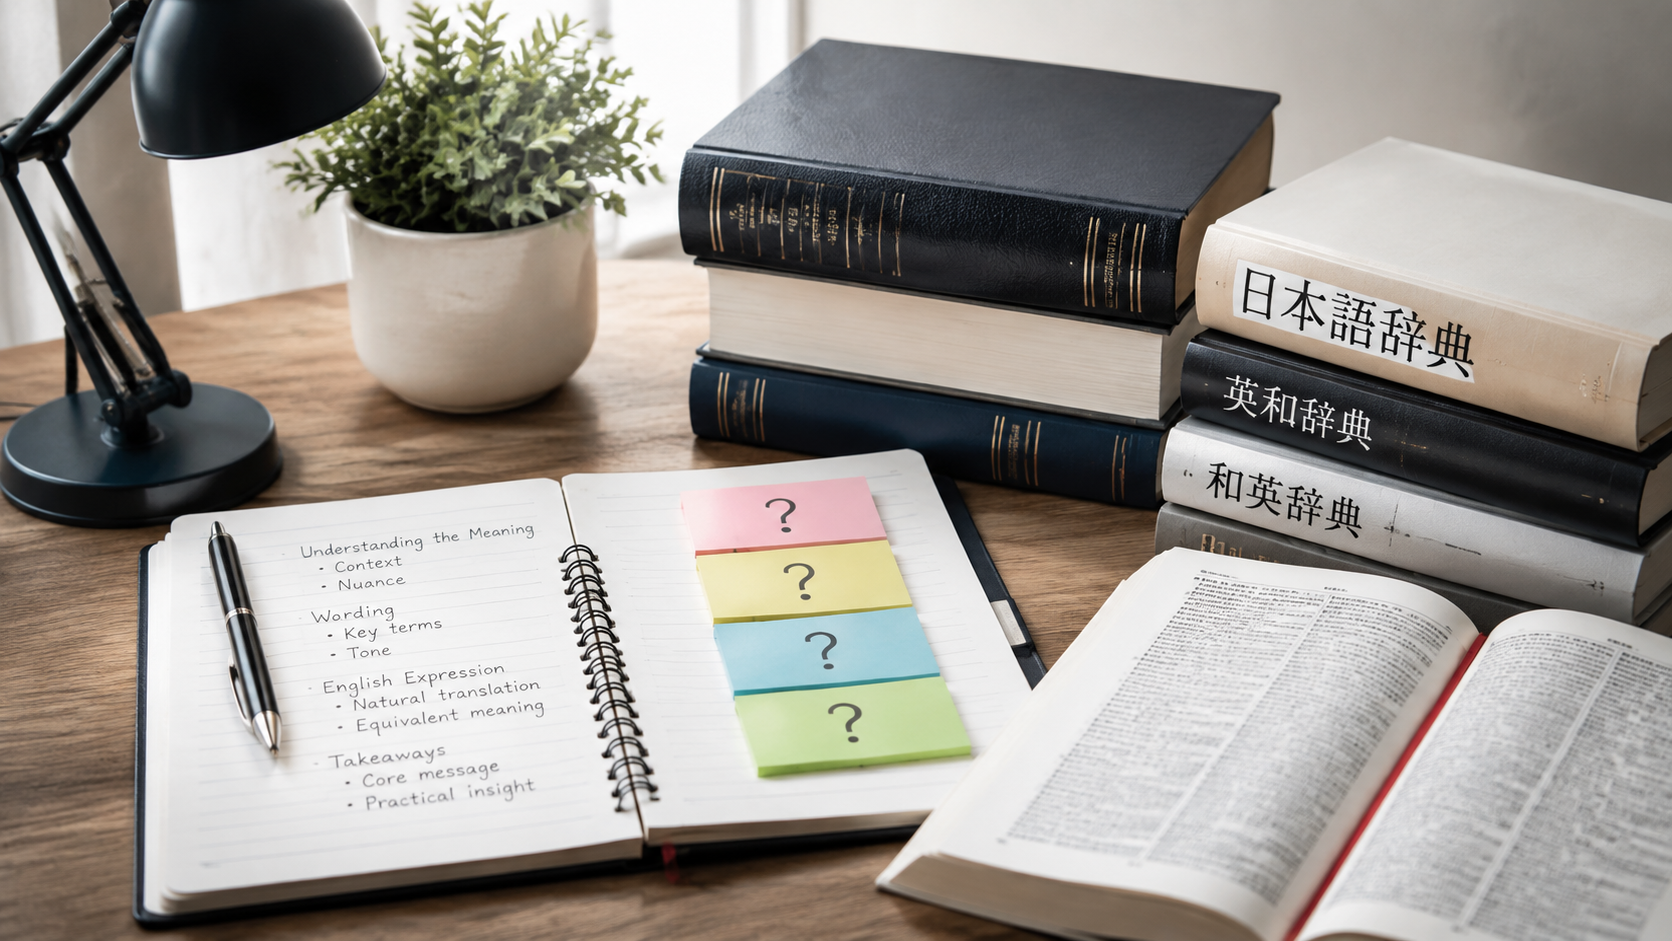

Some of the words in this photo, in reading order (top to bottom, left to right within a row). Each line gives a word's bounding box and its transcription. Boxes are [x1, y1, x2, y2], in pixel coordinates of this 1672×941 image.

[1242, 267, 1474, 378] 日本語辞典
[1223, 375, 1372, 451] 英和辞典
[765, 498, 797, 533] ?
[1206, 462, 1362, 539] 和英辞典
[300, 535, 424, 559] Understanding
[432, 531, 460, 544] the
[469, 524, 535, 540] Meaning
[334, 556, 403, 573] Context
[783, 563, 815, 600] ?
[337, 574, 406, 591] Nuance
[311, 604, 395, 624] Wording
[344, 626, 378, 643] Key
[389, 618, 443, 635] terms
[346, 645, 392, 660] Tone
[804, 631, 838, 670] ?
[323, 674, 393, 698] English
[404, 663, 506, 688] Expression
[353, 690, 426, 711] Natural
[438, 680, 541, 701] translation
[357, 708, 459, 736] Equivalent
[470, 700, 545, 718] meaning
[827, 702, 862, 743] ?
[328, 745, 446, 769] Takeaways
[362, 772, 408, 788] Core
[419, 761, 500, 780] message
[366, 787, 454, 811] Practical
[468, 778, 536, 801] insight
